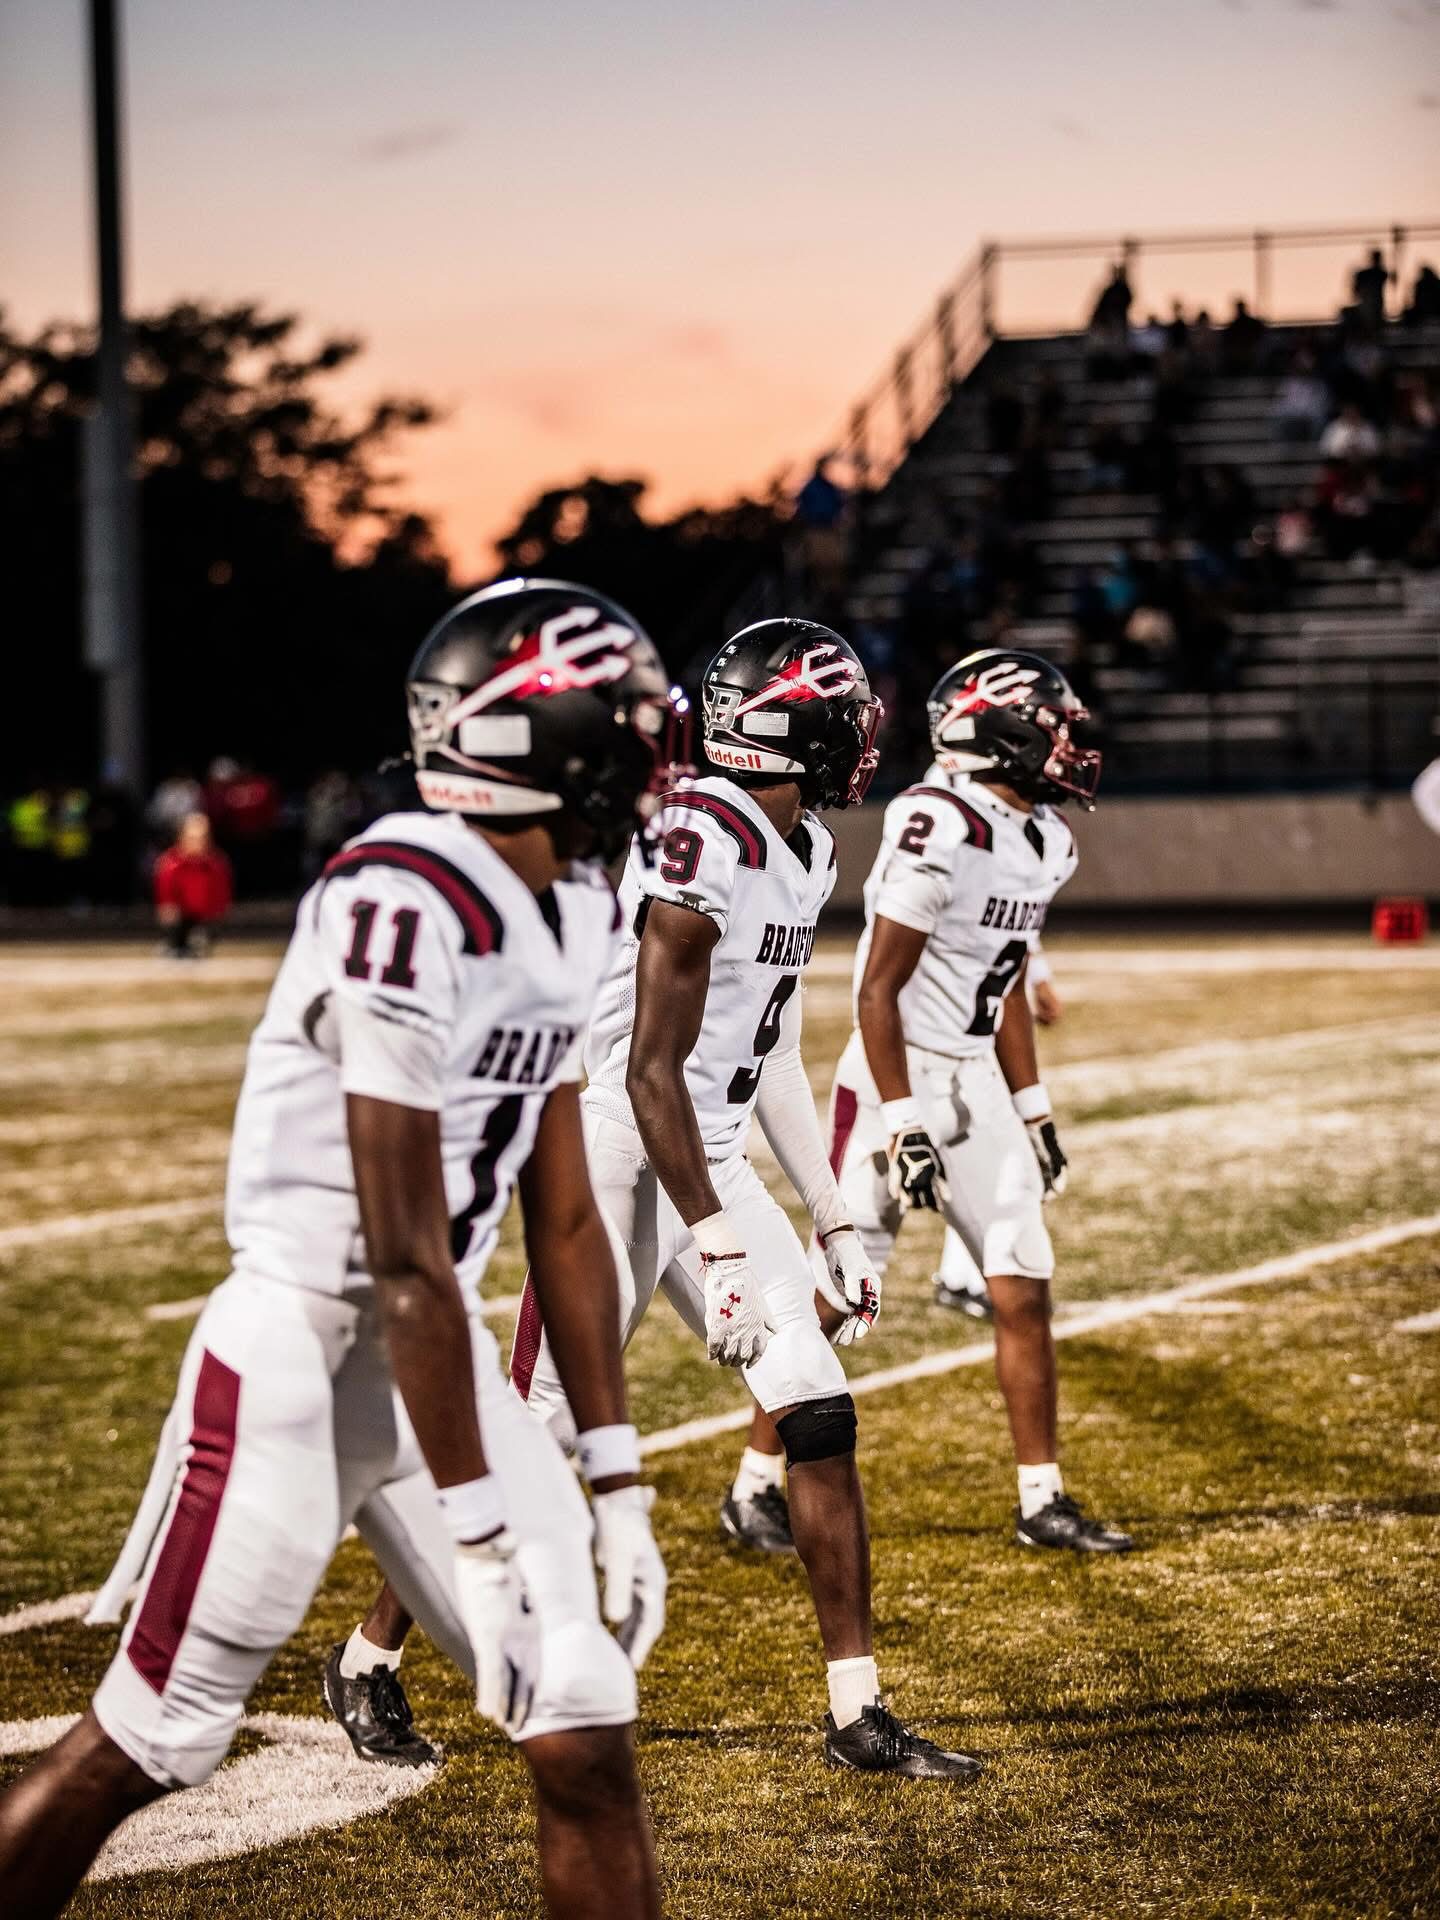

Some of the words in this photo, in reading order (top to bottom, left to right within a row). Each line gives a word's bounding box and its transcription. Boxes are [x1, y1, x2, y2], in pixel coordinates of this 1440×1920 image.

[660, 827, 704, 885] 9
[898, 811, 935, 857] 2
[345, 898, 420, 989] 11
[965, 940, 1027, 1036] 2
[727, 974, 798, 1105] 9
